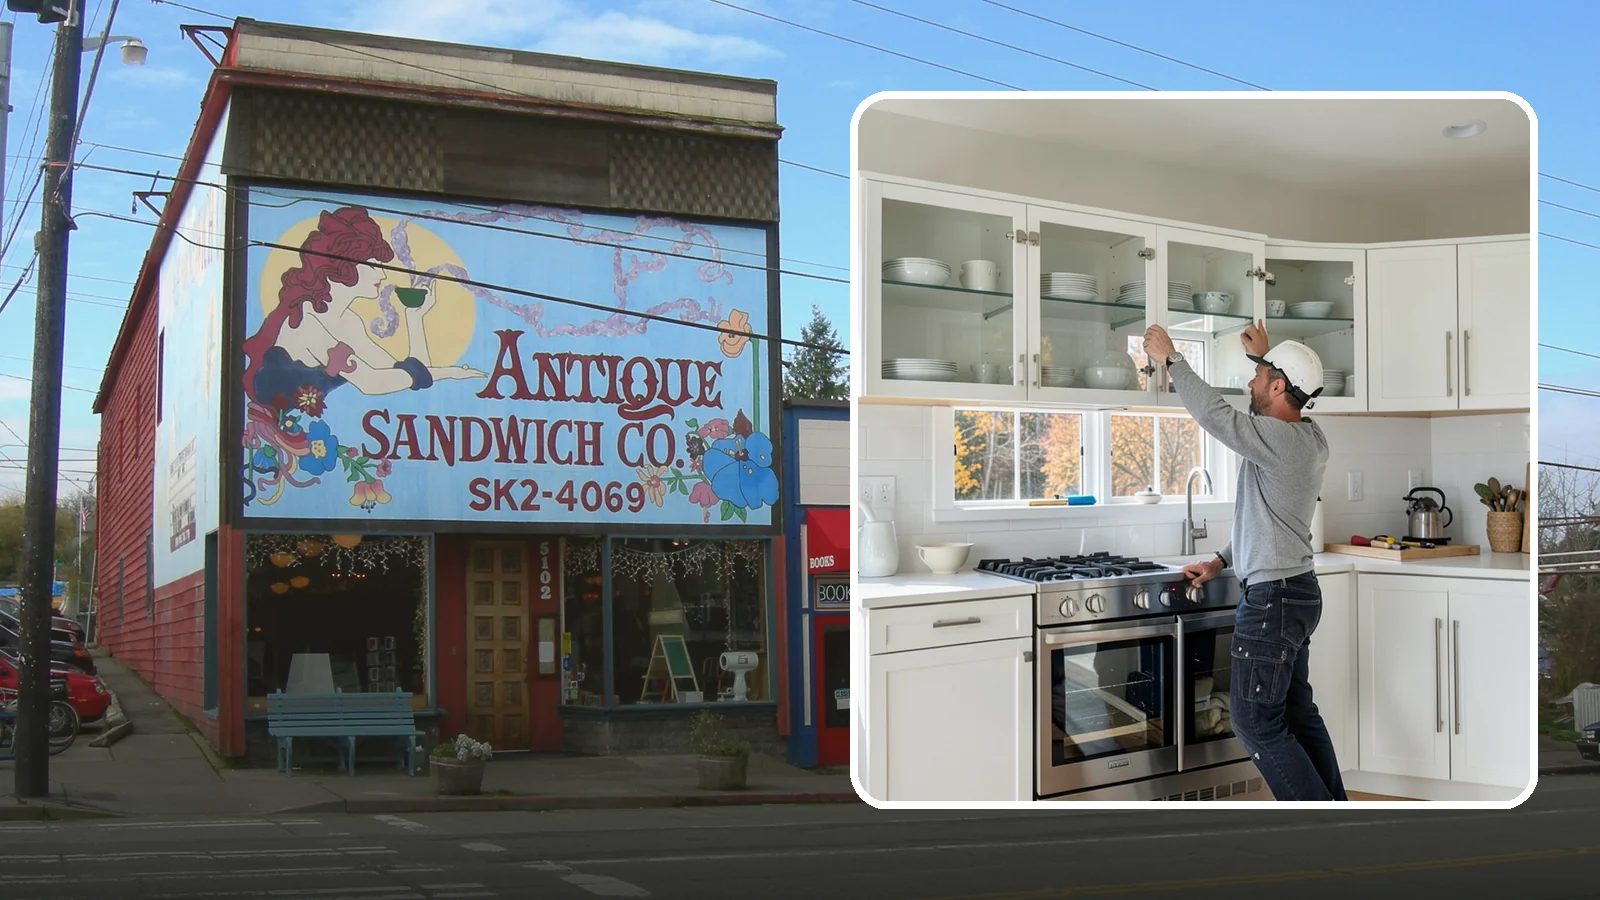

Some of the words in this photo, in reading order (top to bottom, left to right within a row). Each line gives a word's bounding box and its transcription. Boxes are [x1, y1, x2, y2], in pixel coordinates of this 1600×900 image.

[476, 329, 724, 421] ANTIQUE
[361, 408, 604, 467] SANDWICH
[617, 421, 685, 469] CO.
[468, 477, 646, 513] SK2-4069
[540, 541, 551, 600] 5102
[809, 555, 835, 569] BOOKS
